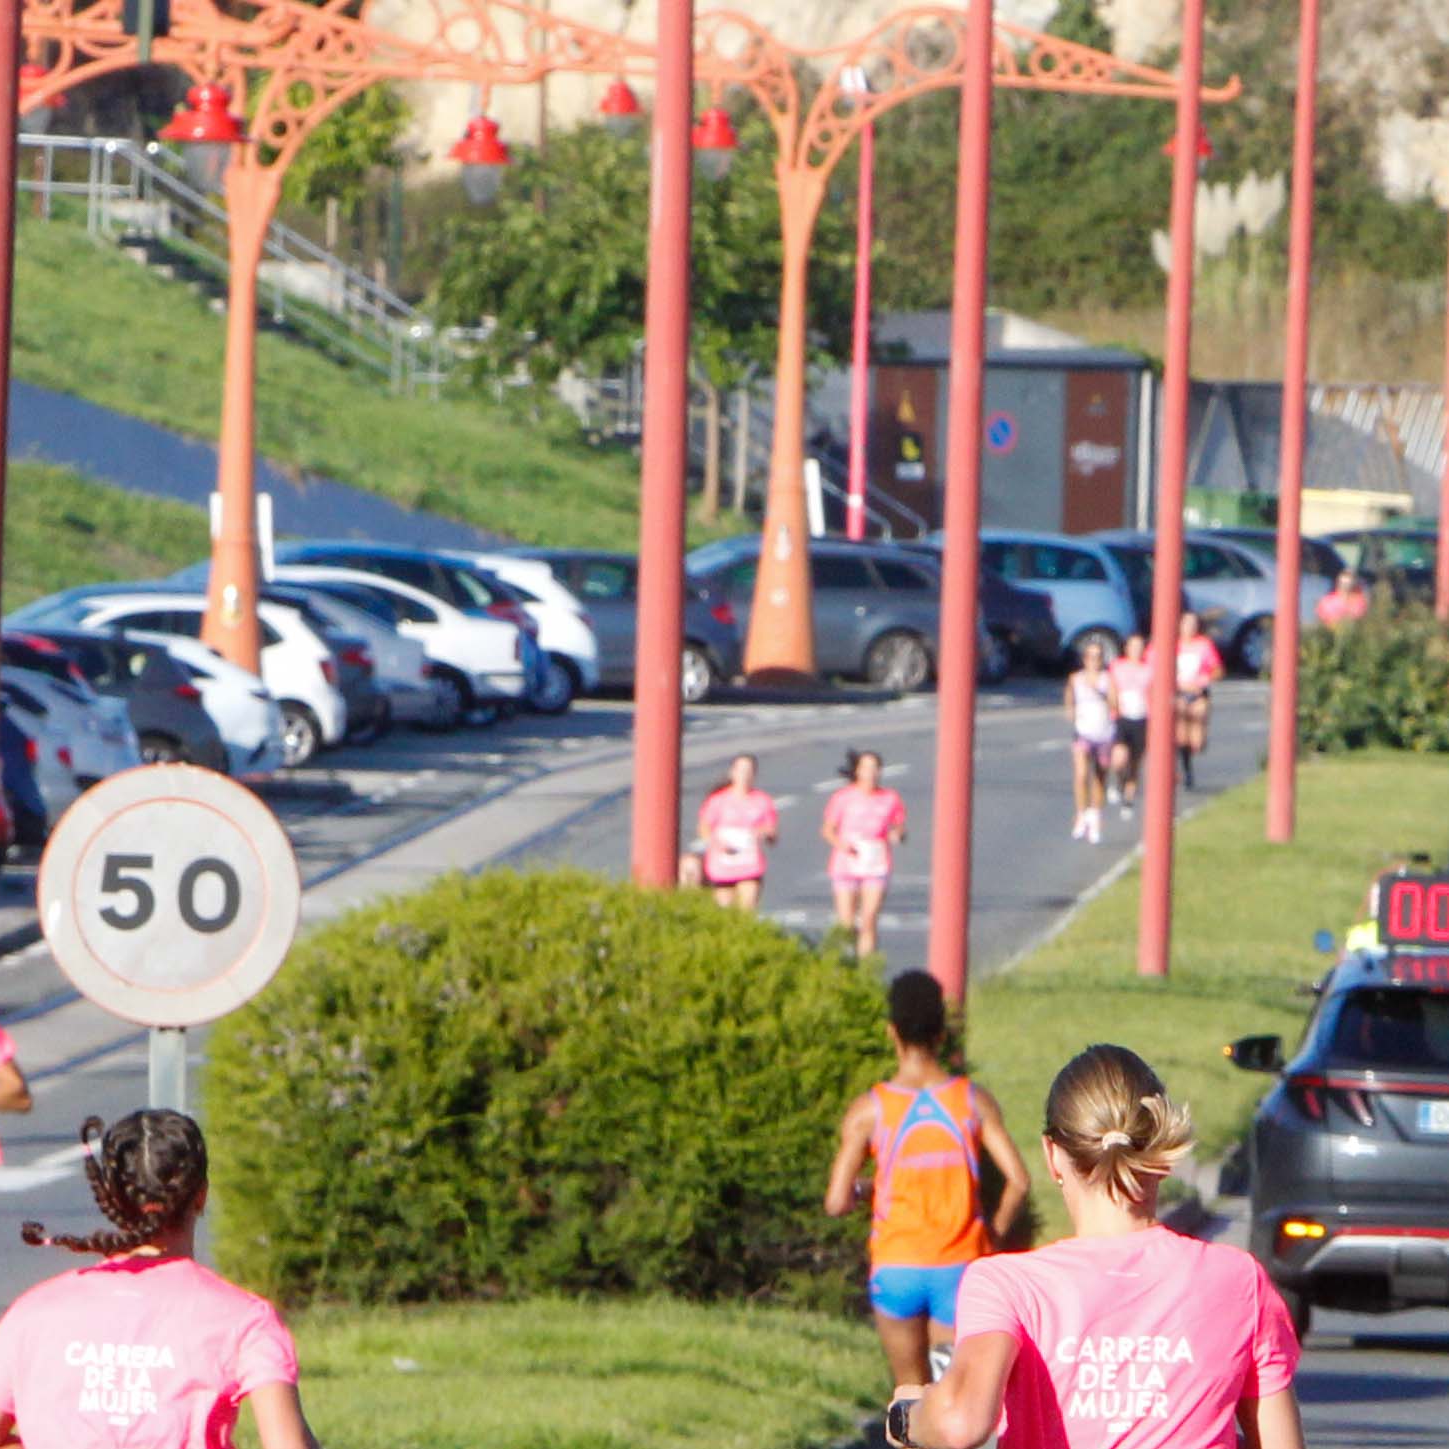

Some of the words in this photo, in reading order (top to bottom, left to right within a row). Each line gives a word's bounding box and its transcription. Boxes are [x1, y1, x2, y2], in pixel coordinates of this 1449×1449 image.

[99, 854, 241, 933] 50
[64, 1341, 175, 1368] CARRERA
[1055, 1335, 1194, 1363] CARRERA
[85, 1365, 117, 1389] DE
[123, 1366, 152, 1391] LA
[1078, 1363, 1118, 1390] DE
[1128, 1363, 1166, 1390] LA
[79, 1389, 158, 1415] MUJER
[1069, 1391, 1168, 1419] MUJER
